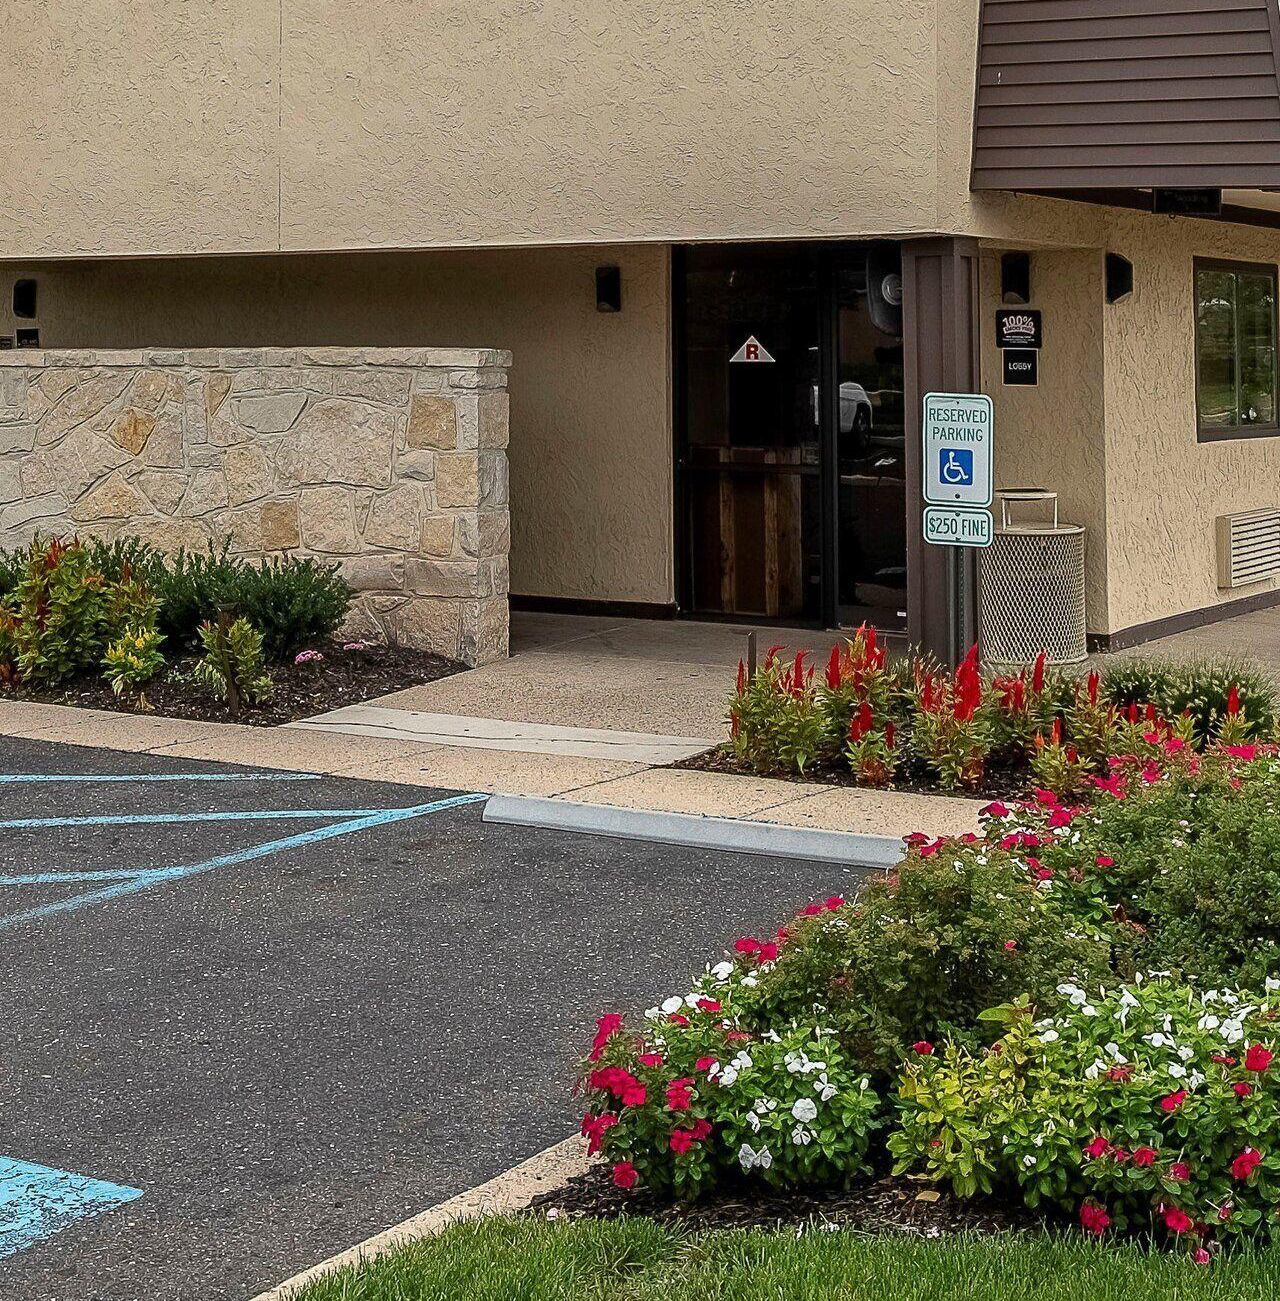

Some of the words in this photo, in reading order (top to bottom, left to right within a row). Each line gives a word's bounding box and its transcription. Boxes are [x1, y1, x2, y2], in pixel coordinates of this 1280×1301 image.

[1002, 315, 1034, 329] 100%
[745, 343, 759, 360] R
[928, 407, 987, 424] RESERVED
[932, 426, 983, 442] PARKING
[928, 516, 958, 536] $250
[961, 519, 987, 537] FINE
